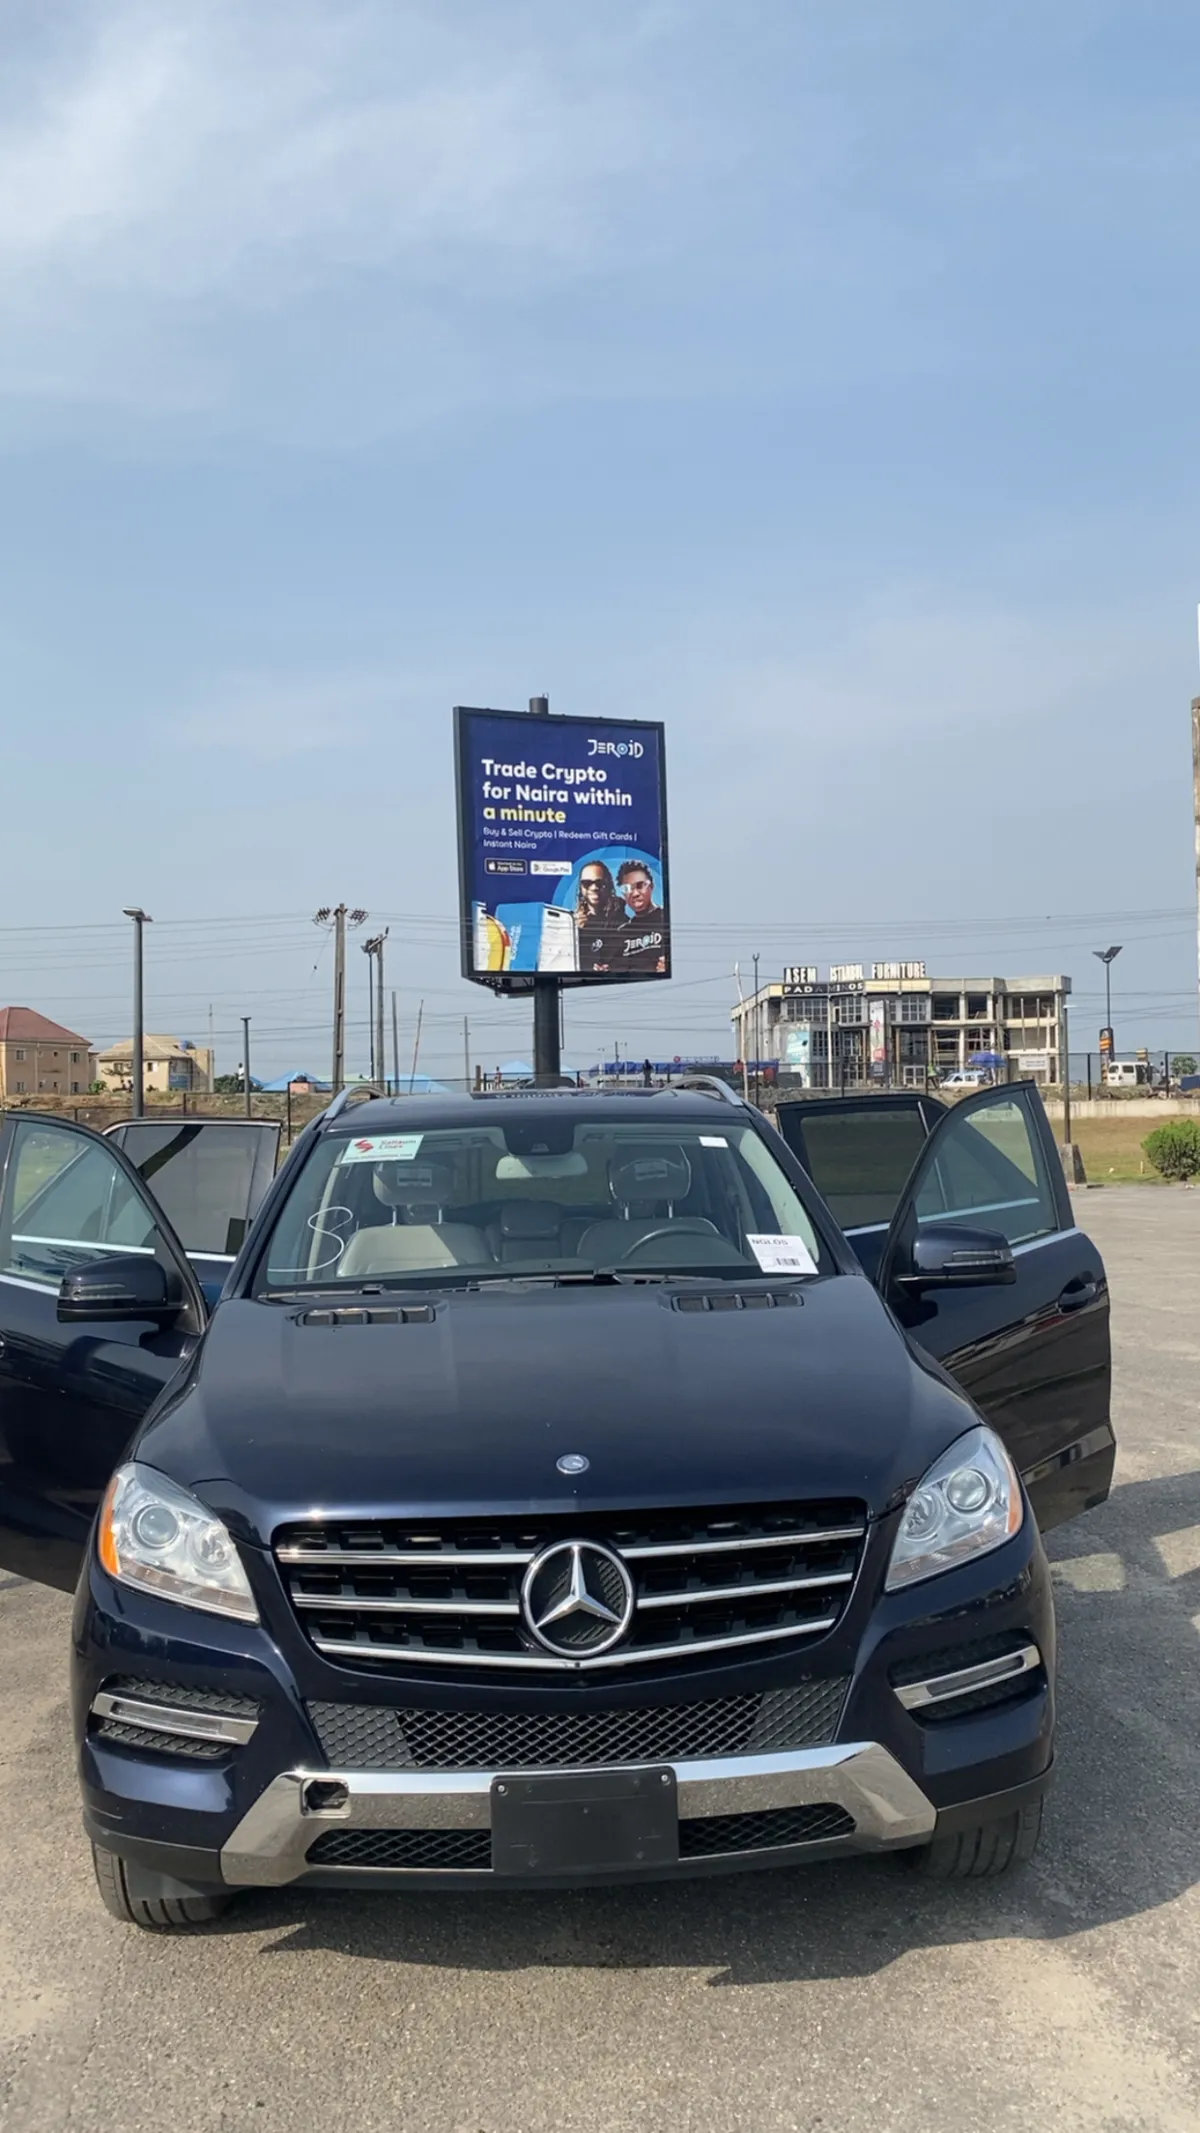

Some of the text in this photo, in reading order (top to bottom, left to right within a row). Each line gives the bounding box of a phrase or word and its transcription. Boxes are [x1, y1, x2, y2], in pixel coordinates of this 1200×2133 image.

[481, 759, 607, 785] Trade Crypto
[482, 781, 632, 807] for Naira within
[483, 804, 566, 824] a minute
[483, 827, 500, 838] Buy
[501, 828, 506, 836] &
[508, 828, 523, 837] Sell
[525, 830, 553, 840] Crypto
[558, 831, 591, 840] Redeem
[592, 832, 608, 841] Gift
[609, 832, 633, 841] Cards
[483, 839, 537, 849] Instant Naira
[872, 961, 926, 979] FURNITURE
